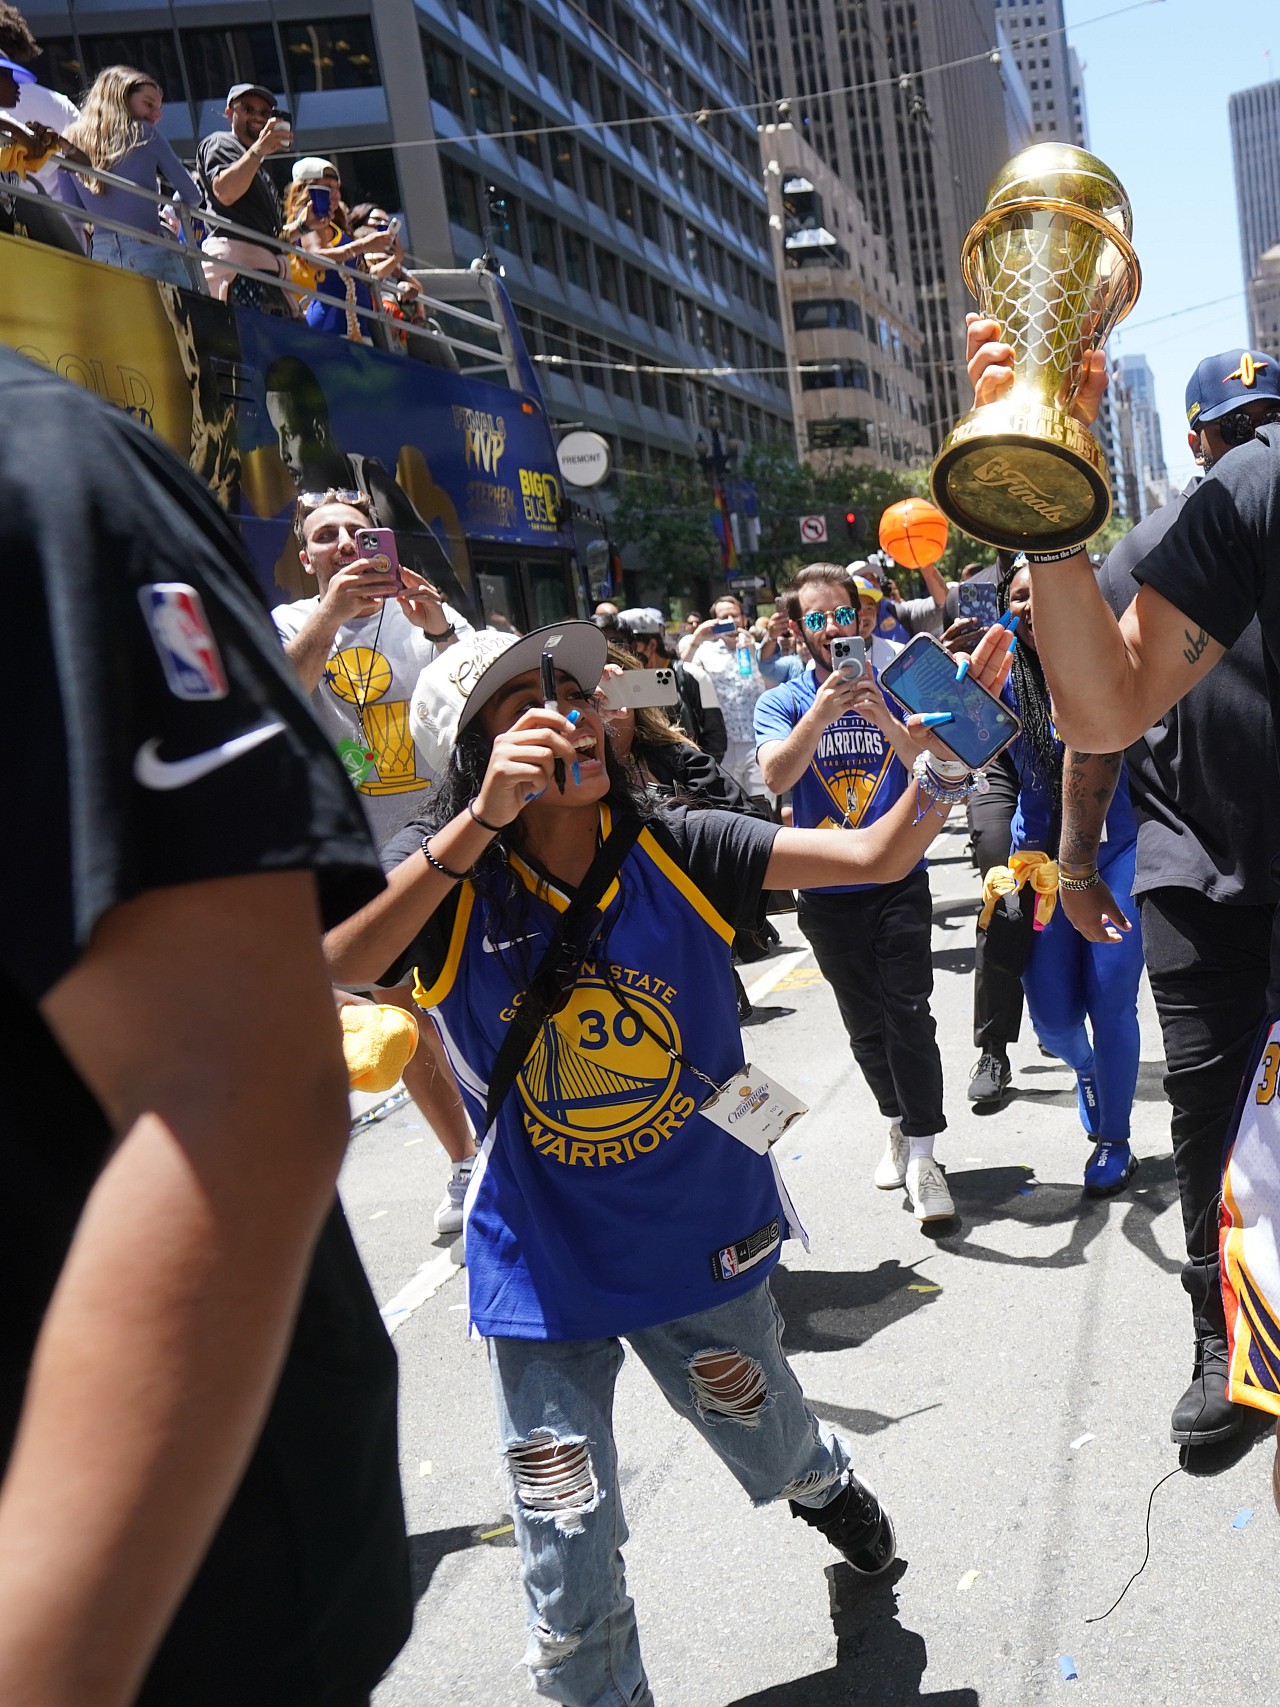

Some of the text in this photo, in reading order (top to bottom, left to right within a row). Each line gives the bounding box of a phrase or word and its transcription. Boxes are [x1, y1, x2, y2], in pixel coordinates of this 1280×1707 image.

[561, 453, 601, 464] FREMONT
[519, 469, 543, 498] BIG
[523, 496, 547, 523] BUS
[817, 731, 883, 759] WARRIORS
[823, 757, 877, 767] BASETALL
[610, 965, 678, 1005] STATE
[578, 1009, 645, 1050] 30
[728, 1083, 769, 1124] Champions
[523, 1091, 695, 1167] WARRIORS
